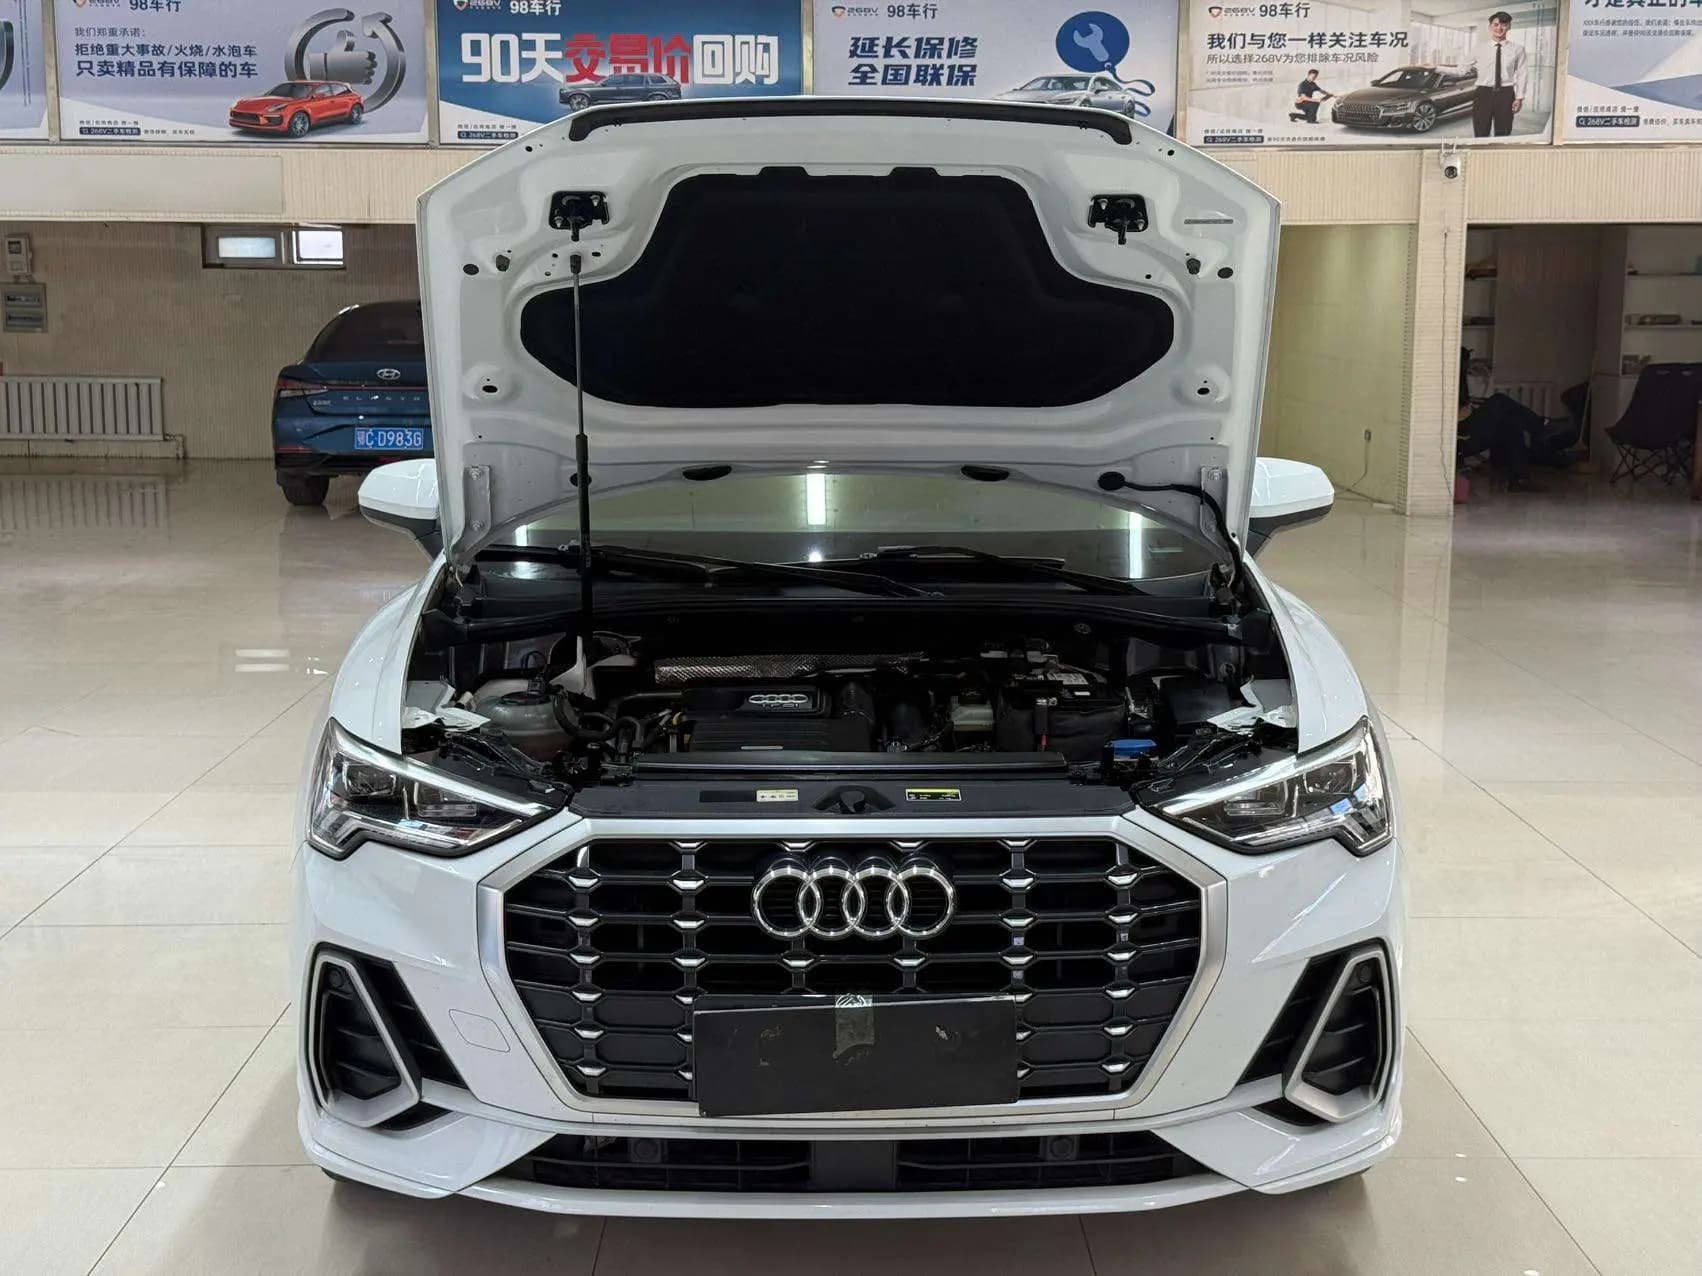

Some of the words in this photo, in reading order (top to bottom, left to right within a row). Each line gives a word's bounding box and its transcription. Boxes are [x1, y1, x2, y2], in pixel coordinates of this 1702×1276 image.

[129, 0, 181, 12] 98车行
[510, 0, 561, 15] 98车行
[887, 3, 938, 19] 98车行
[1259, 2, 1310, 18] 98车行
[848, 36, 979, 59] 延长保修
[1207, 32, 1409, 49] 我们与您一样关注车况
[74, 43, 258, 57] 拒绝重大事故/火烧/水泡车
[460, 33, 779, 85] 90天交易价回购
[1206, 53, 1379, 65] 所以选择268V为您排除车况风险
[76, 60, 259, 79] 只卖精品有保障的车
[847, 64, 978, 86] 全国联保
